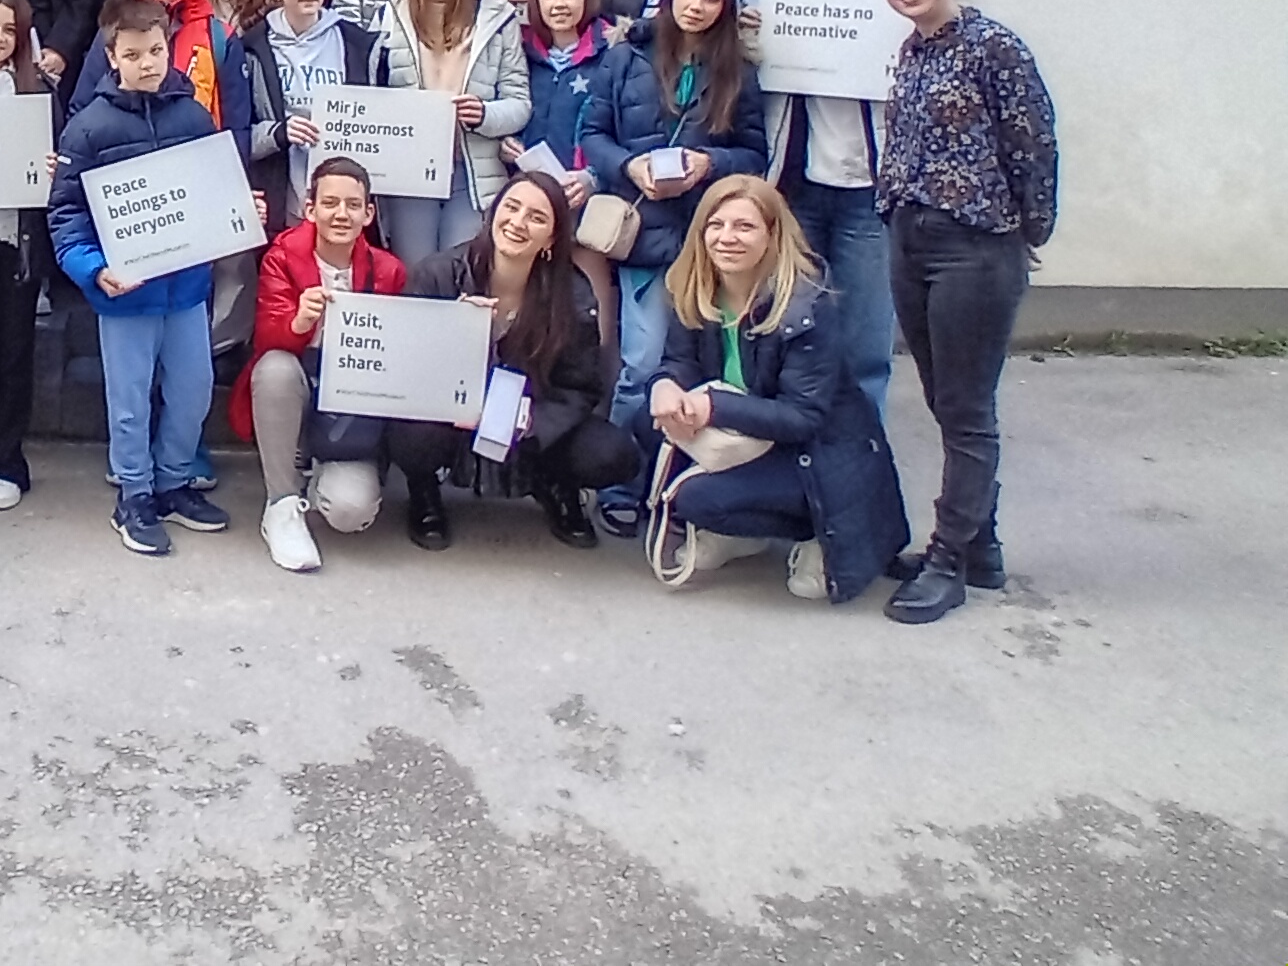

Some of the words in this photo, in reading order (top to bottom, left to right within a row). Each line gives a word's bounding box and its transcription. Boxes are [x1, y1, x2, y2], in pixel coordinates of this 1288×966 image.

[775, 2, 819, 17] Peace
[823, 3, 850, 19] has
[854, 9, 873, 20] no
[773, 22, 858, 39] alternative
[327, 100, 351, 114] Mir
[351, 101, 366, 118] je
[325, 120, 414, 137] odgovornost
[324, 138, 352, 152] svih
[355, 141, 380, 154] nas
[102, 177, 147, 199] Peace
[107, 192, 168, 220] belongs
[169, 187, 187, 202] to
[115, 210, 185, 240] everyone
[342, 311, 383, 330] Visit,
[339, 332, 385, 352] learn,
[338, 354, 386, 372] share.
